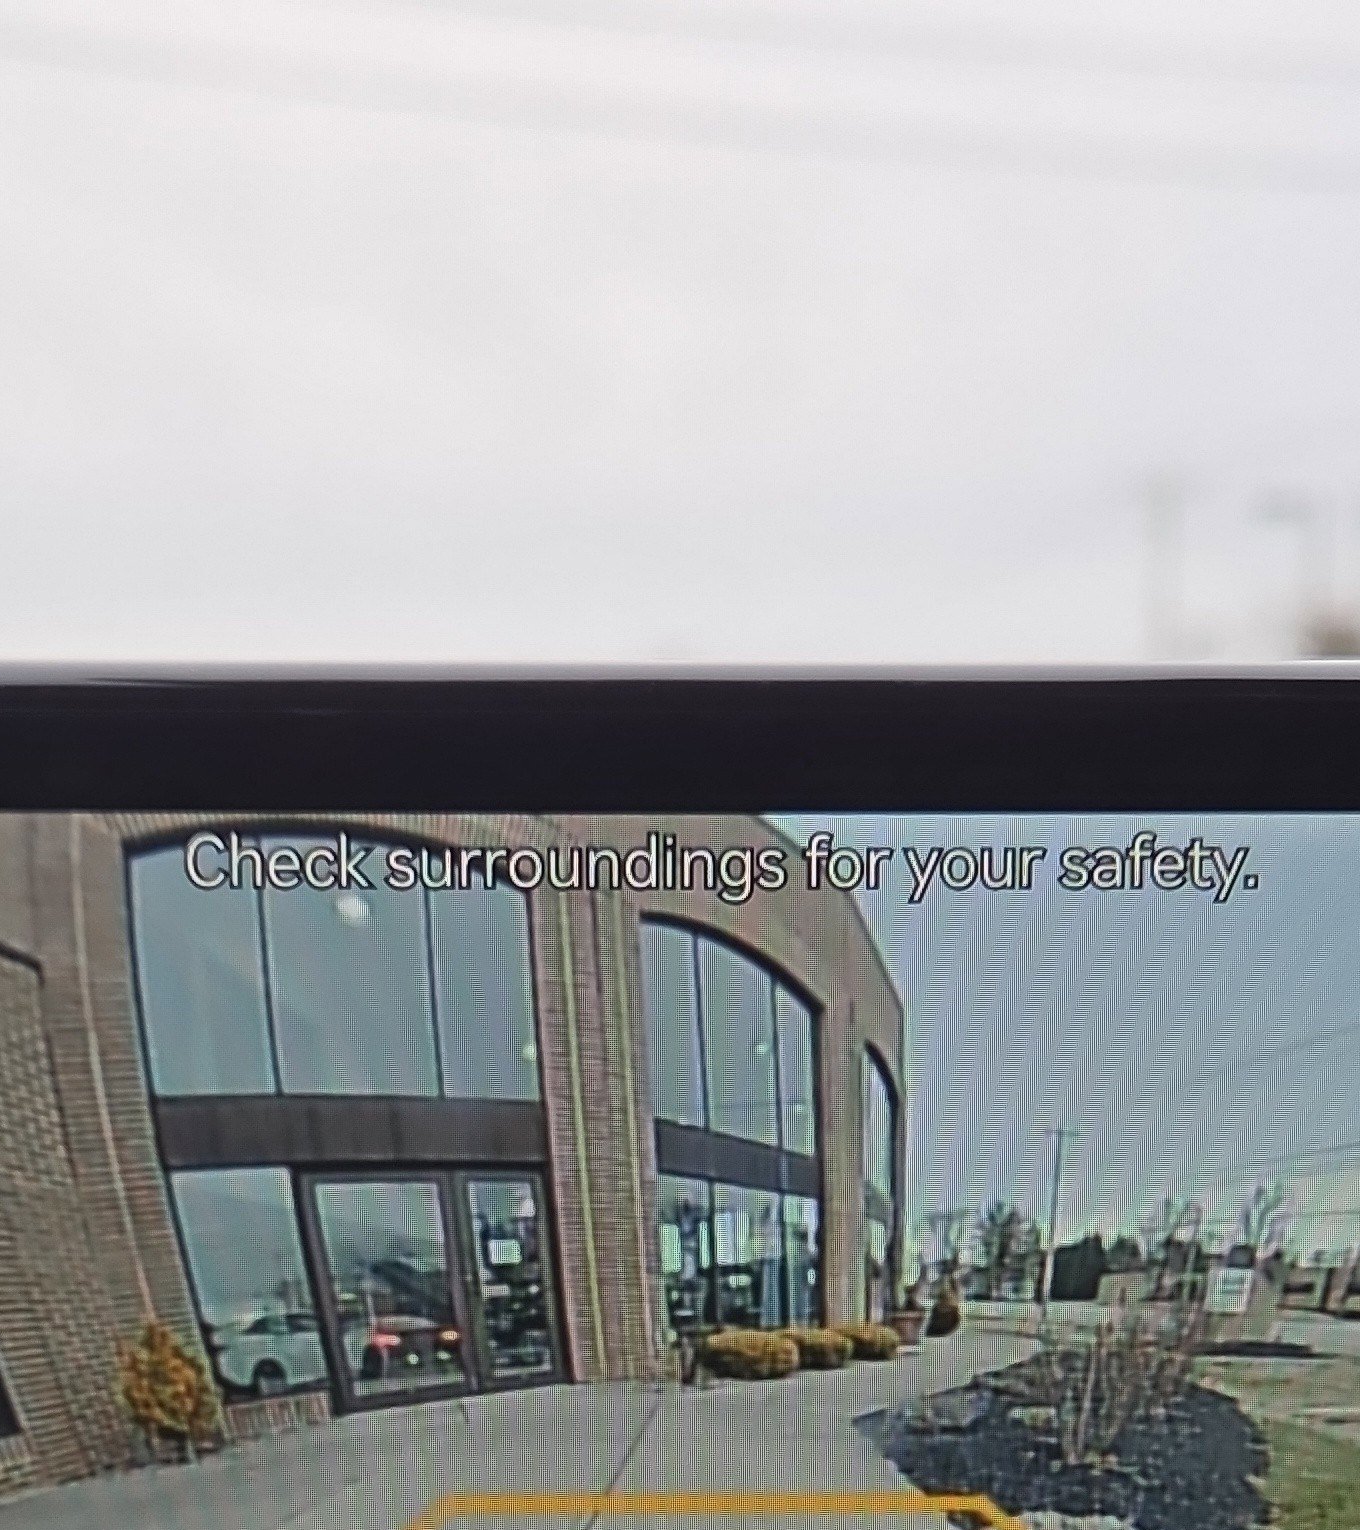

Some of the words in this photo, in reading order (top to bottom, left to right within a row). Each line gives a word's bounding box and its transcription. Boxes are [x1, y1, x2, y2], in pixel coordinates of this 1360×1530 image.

[184, 829, 376, 890] Check
[385, 831, 787, 903] surroundings
[806, 831, 893, 890] for
[904, 845, 1047, 903] your
[1059, 831, 1260, 903] safety.
